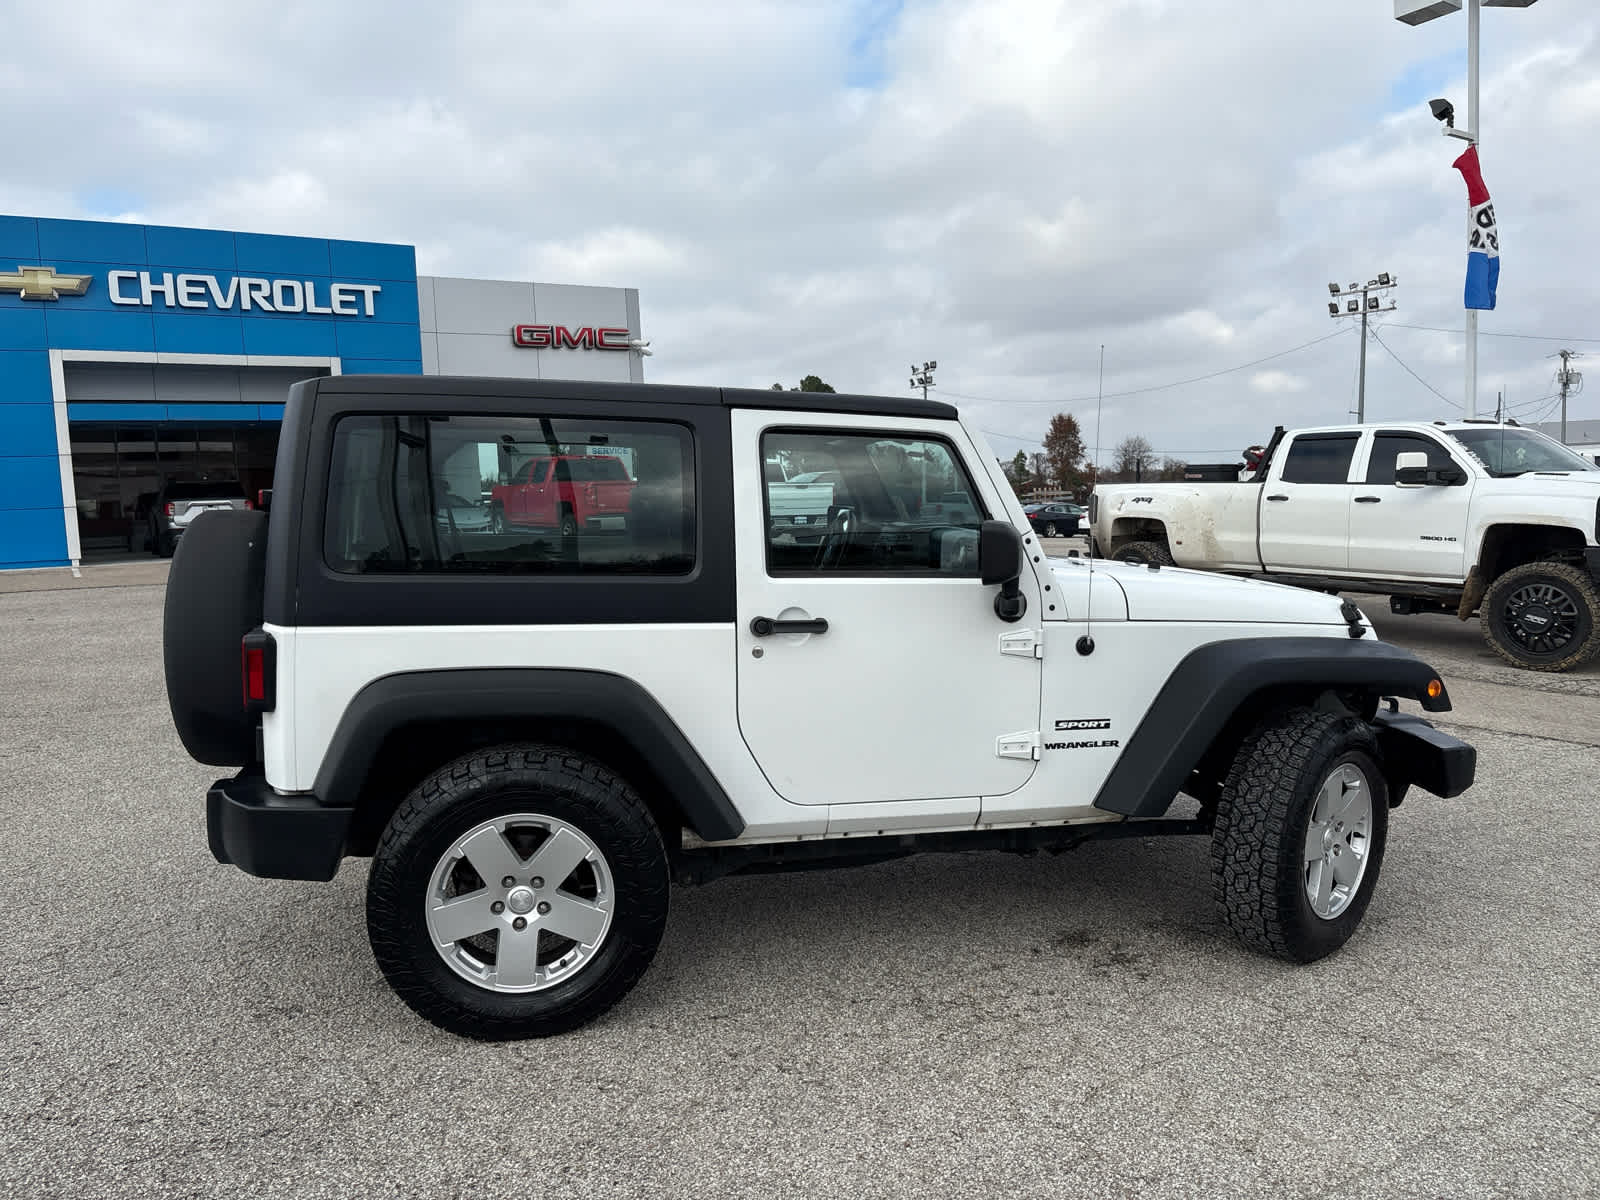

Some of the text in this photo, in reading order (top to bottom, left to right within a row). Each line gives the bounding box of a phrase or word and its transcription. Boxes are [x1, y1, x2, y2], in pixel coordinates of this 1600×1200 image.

[107, 269, 382, 317] CHEVROLET
[513, 324, 632, 351] GMC
[592, 447, 629, 456] SERVICE
[1057, 720, 1110, 729] SPORT
[1044, 740, 1119, 750] WRANGLER
